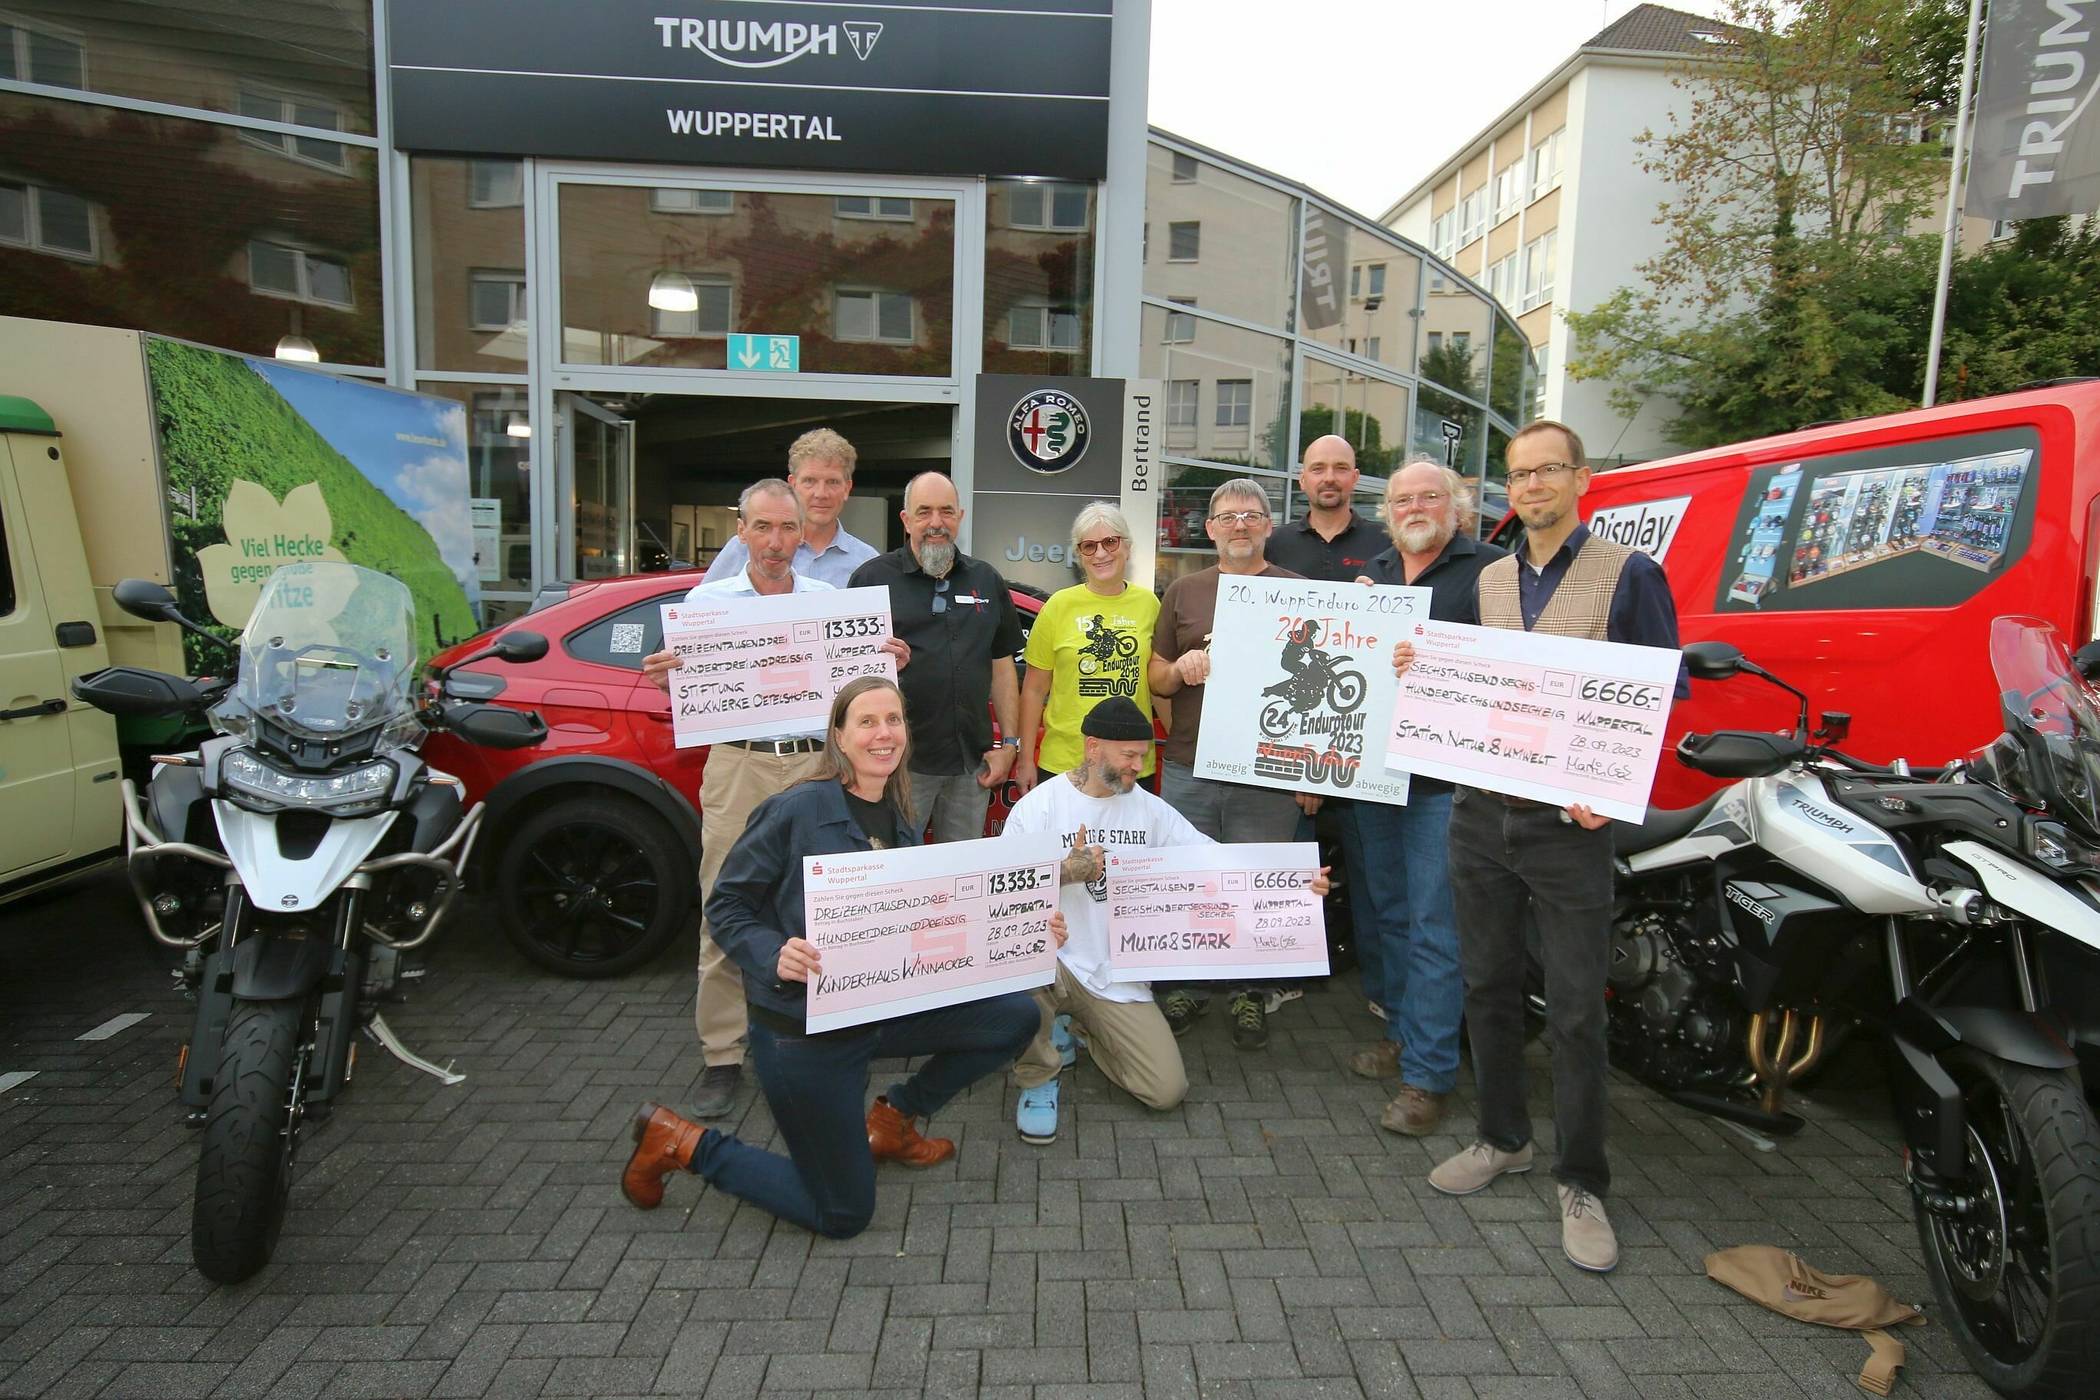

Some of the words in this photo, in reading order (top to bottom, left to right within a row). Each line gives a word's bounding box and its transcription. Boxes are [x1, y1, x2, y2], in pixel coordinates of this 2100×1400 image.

[654, 17, 837, 68] TRIUMPH
[666, 109, 842, 141] WUPPERTAL
[1013, 398, 1040, 431] ALFA
[1045, 395, 1086, 435] ROMEO
[1131, 395, 1151, 492] Bertrand
[1592, 507, 1675, 556] Display
[240, 538, 270, 557] Viel
[274, 534, 324, 557] Hecke
[231, 565, 272, 584] gegen
[1227, 585, 1256, 605] 20.
[1265, 590, 1360, 612] WuppEnduro
[1366, 594, 1416, 614] 2023
[681, 610, 729, 619] Stadtsparkasse
[681, 619, 716, 627] Wuppertal
[1275, 616, 1309, 643] 20
[1314, 617, 1378, 650] Jahre
[1426, 630, 1477, 643] Stadtsparkasse
[824, 644, 886, 659] WUPPERTAL
[1426, 639, 1460, 649] Wuppertal
[1120, 667, 1140, 678] 2018
[1550, 680, 1564, 688] EUR
[681, 697, 750, 716] KALKWERKE
[1266, 708, 1289, 729] 24
[1299, 711, 1367, 735] Endurotour
[1577, 710, 1653, 735] WUPPERTAL
[1328, 732, 1364, 754] 2023
[1206, 760, 1248, 776] abwegig
[1355, 780, 1400, 796] abwegig
[1792, 799, 1855, 834] TRIUMPH
[1098, 829, 1105, 843] &
[1110, 830, 1146, 845] STARK
[827, 863, 885, 875] Stadtsparkasse
[827, 873, 868, 884] Wuppertal
[1122, 865, 1151, 873] Wuppertal
[961, 884, 975, 892] EUR
[988, 899, 1053, 918] WUPPERTAL
[1253, 898, 1313, 911] WUPPERTAL
[1725, 884, 1776, 925] TIGER
[1789, 1280, 1826, 1298] NIKE
